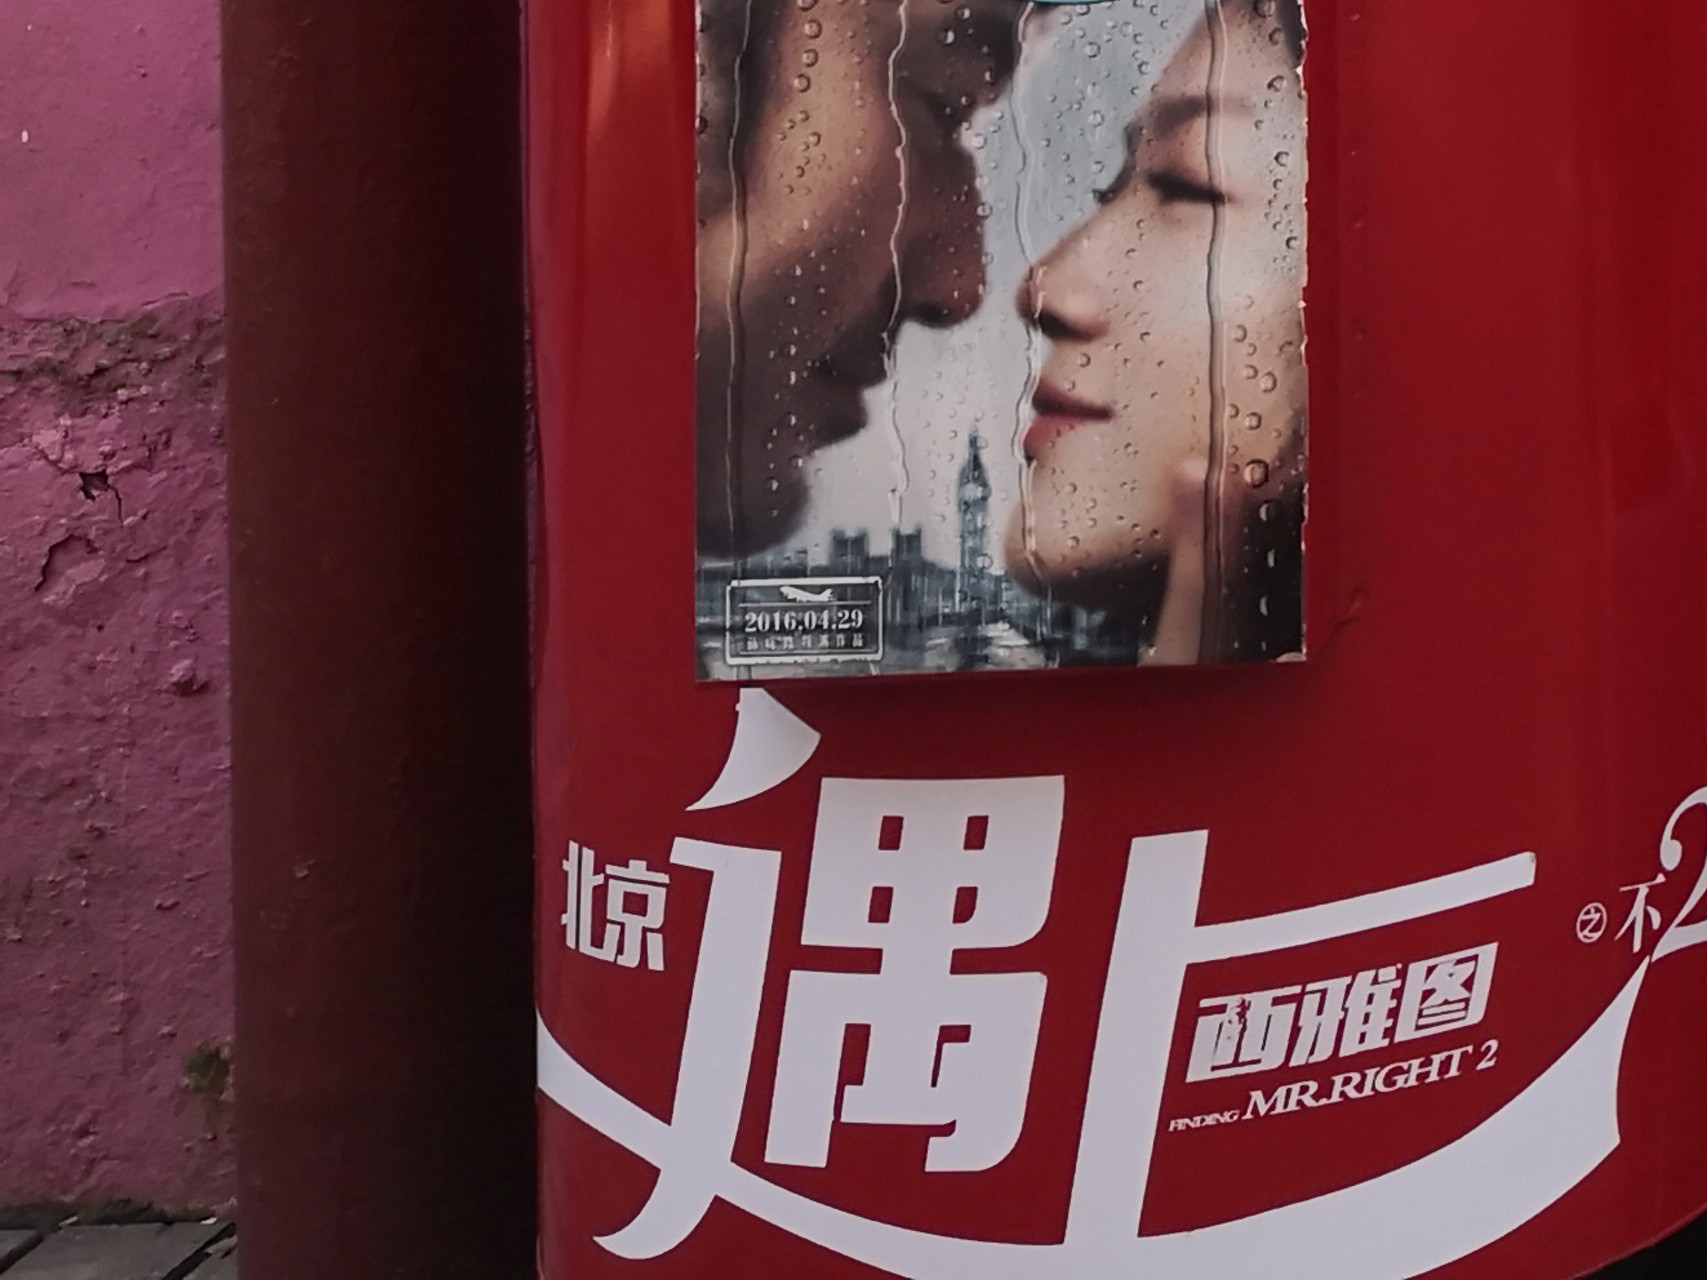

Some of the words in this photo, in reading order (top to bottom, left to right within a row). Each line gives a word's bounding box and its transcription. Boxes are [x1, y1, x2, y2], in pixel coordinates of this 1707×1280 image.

[744, 608, 864, 634] 2016.04.29
[561, 839, 671, 972] 北京
[536, 687, 1650, 1280] 遇上
[1185, 941, 1499, 1083] 西雅图
[1168, 1109, 1240, 1133] FINDING
[1241, 1045, 1474, 1121] MR.RIGHT
[1476, 1038, 1500, 1073] 2
